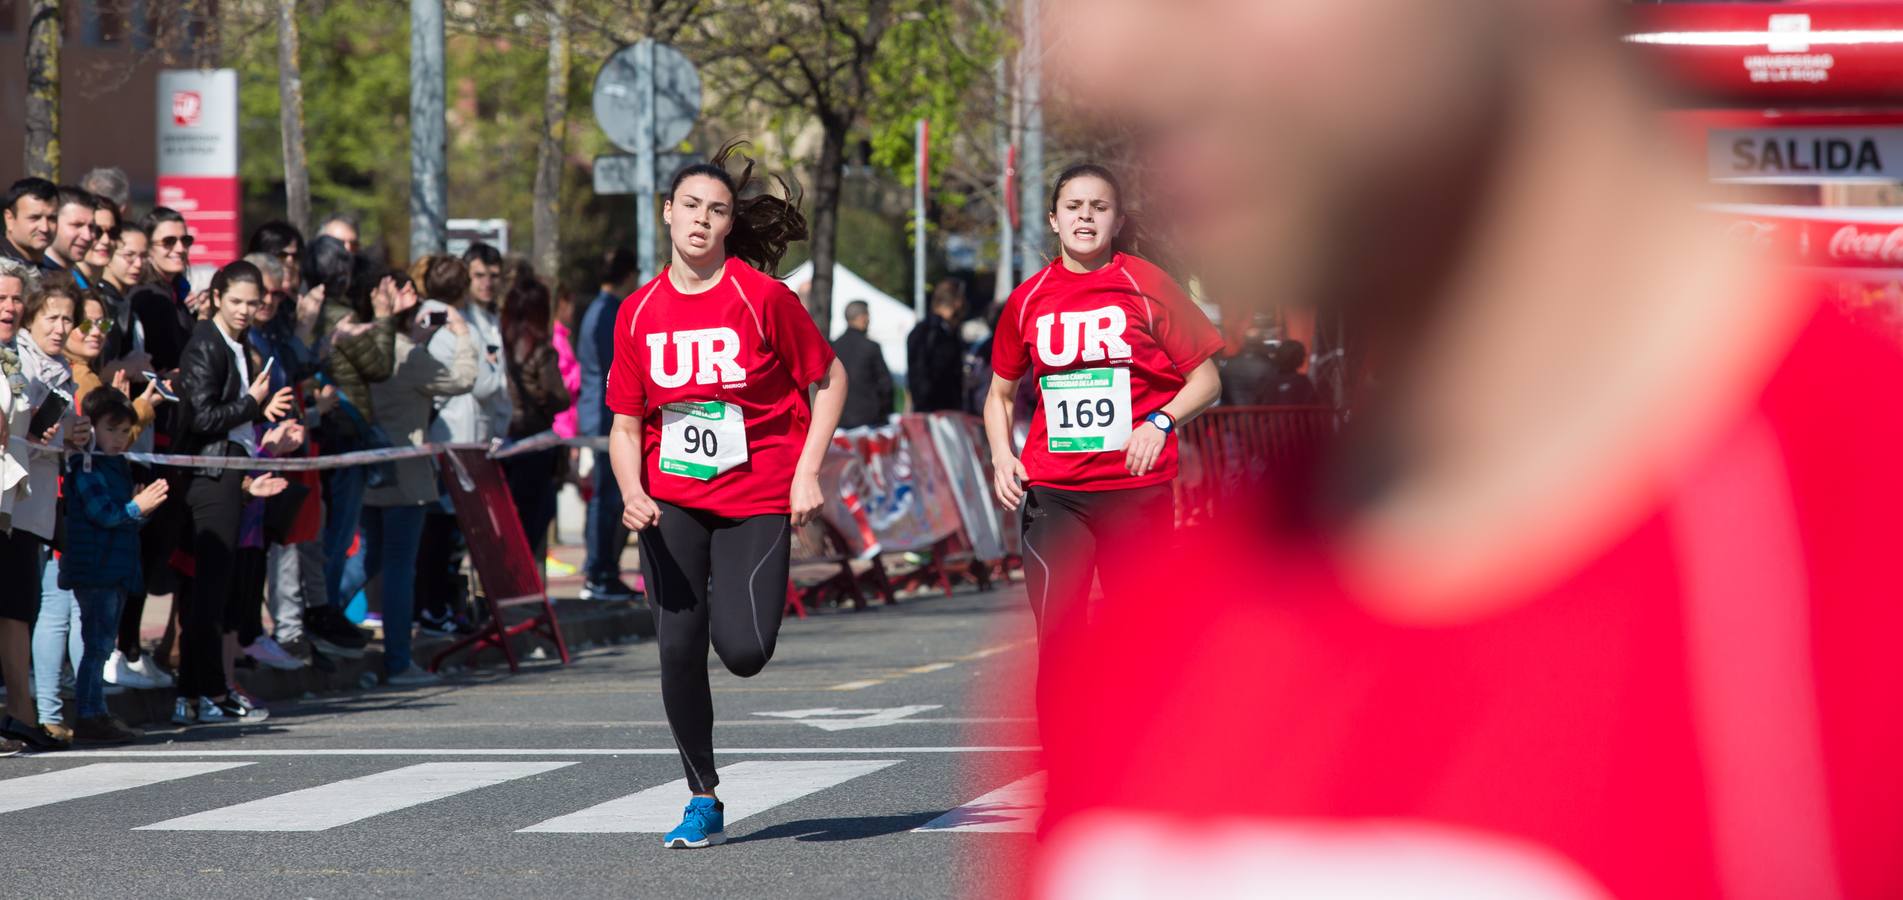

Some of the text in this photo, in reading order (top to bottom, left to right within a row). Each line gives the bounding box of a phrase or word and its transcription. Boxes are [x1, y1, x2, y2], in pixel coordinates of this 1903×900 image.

[1731, 137, 1883, 171] SALIDA
[1036, 305, 1132, 367] UR
[646, 326, 747, 388] UR
[1057, 398, 1115, 429] 169
[684, 425, 718, 457] 90
